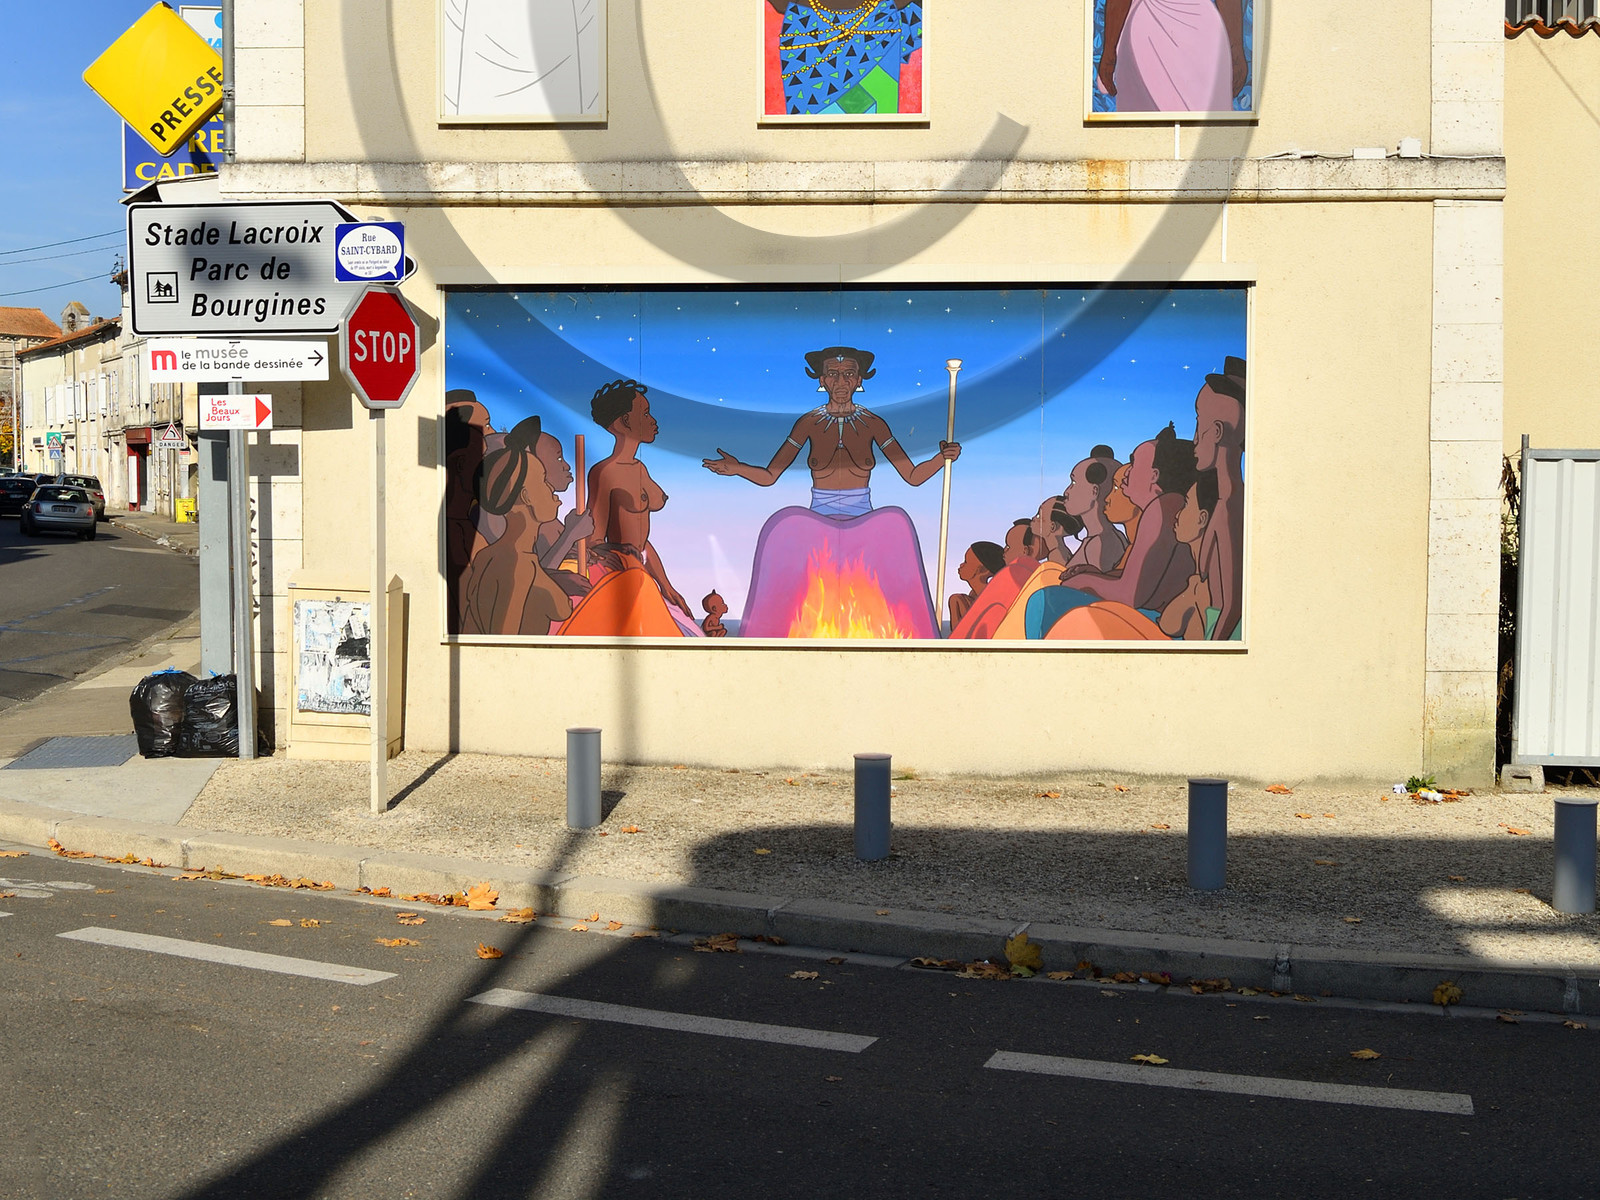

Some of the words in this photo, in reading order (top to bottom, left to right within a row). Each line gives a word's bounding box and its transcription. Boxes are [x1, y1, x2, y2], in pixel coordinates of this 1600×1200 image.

[149, 66, 223, 143] PRESSE
[145, 221, 220, 246] Stade
[228, 220, 324, 245] Lacroix
[361, 233, 377, 242] Rue
[341, 245, 398, 256] SAINT-CYBARD
[190, 257, 249, 281] Parc
[260, 256, 291, 280] de
[191, 292, 326, 323] Bourgines
[181, 350, 191, 360] le
[195, 344, 248, 359] musée
[354, 329, 411, 363] STOP
[182, 361, 197, 370] de
[200, 361, 210, 370] la
[213, 360, 250, 370] bande
[254, 358, 303, 368] dessinée
[211, 398, 227, 406] Les
[206, 413, 231, 422] Jours
[211, 407, 240, 415] Beaux
